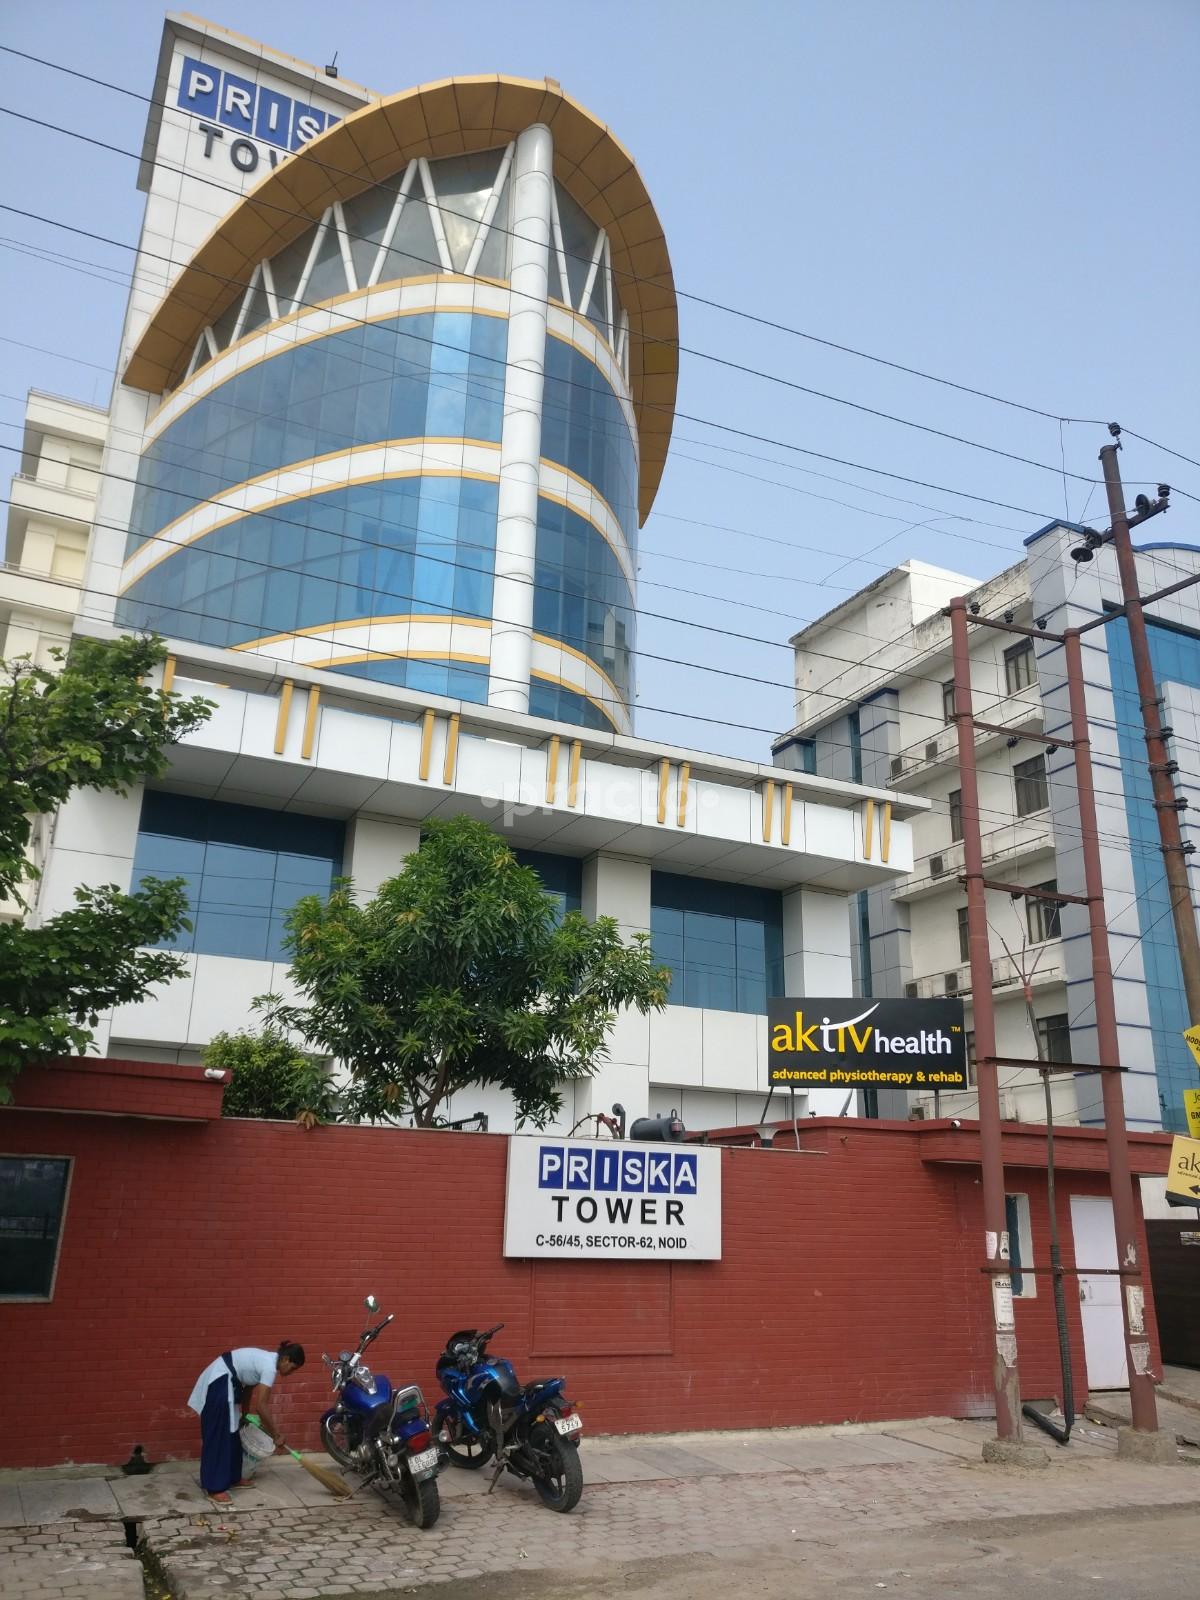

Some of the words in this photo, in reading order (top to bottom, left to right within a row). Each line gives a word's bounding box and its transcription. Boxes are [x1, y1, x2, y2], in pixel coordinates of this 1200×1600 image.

[772, 1068, 827, 1081] advanced
[829, 1069, 913, 1084] physiotherapy
[916, 1071, 926, 1083] &
[928, 1071, 963, 1083] rehab
[542, 1154, 697, 1188] PRISKA
[551, 1195, 686, 1226] TOWER
[535, 1234, 583, 1250] C-56/45,
[585, 1235, 656, 1251] SECTOR-62,
[658, 1236, 687, 1250] NOID
